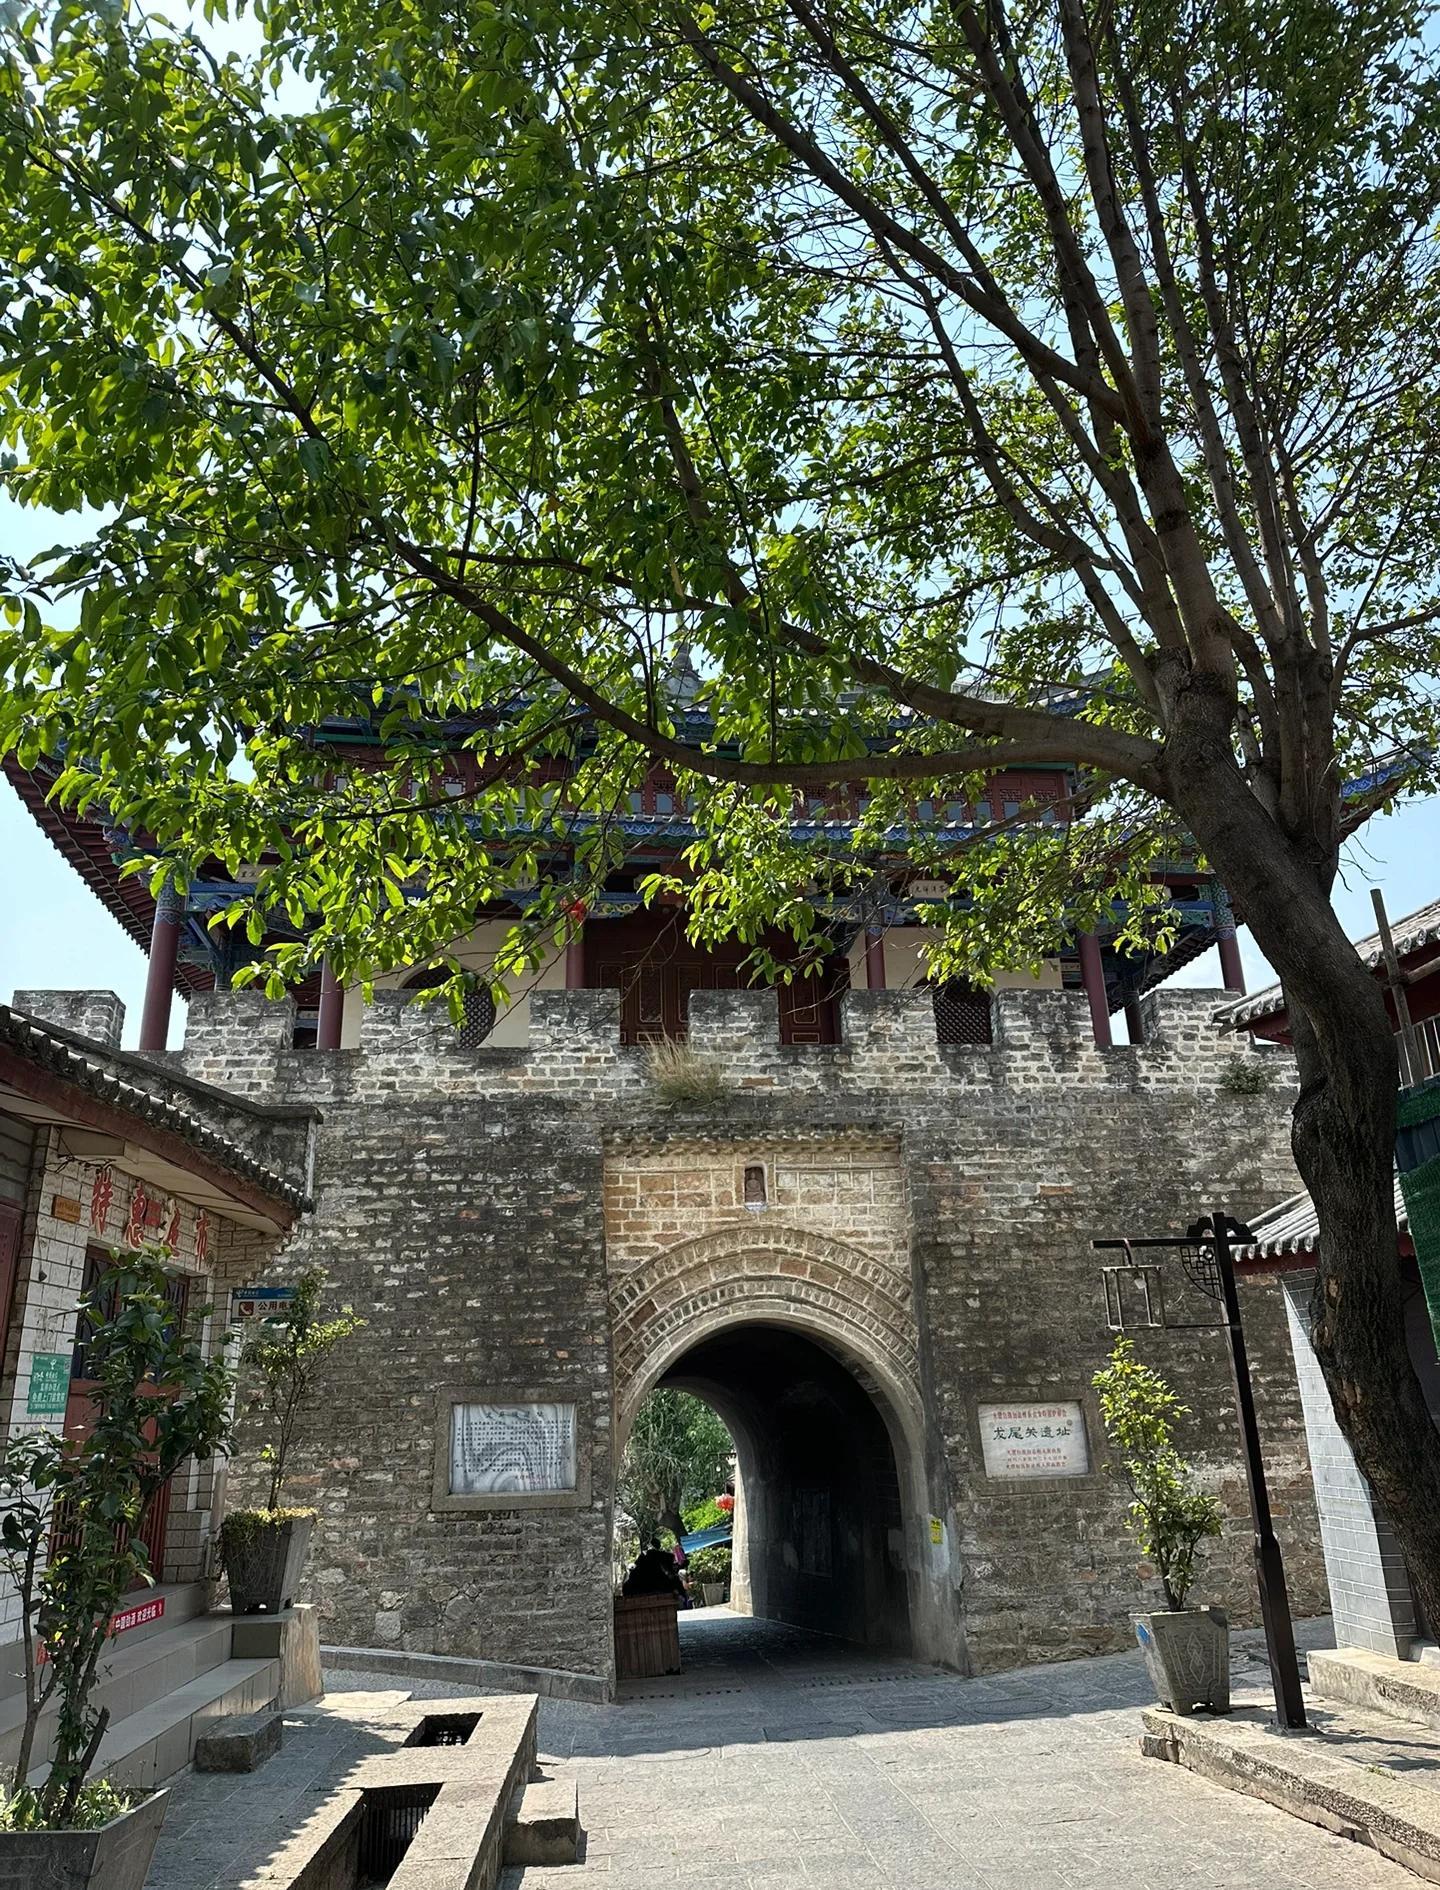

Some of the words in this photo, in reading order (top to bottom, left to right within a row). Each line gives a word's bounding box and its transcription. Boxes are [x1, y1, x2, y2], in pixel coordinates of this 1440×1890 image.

[993, 1425, 1071, 1441] 龙尾关遗址
